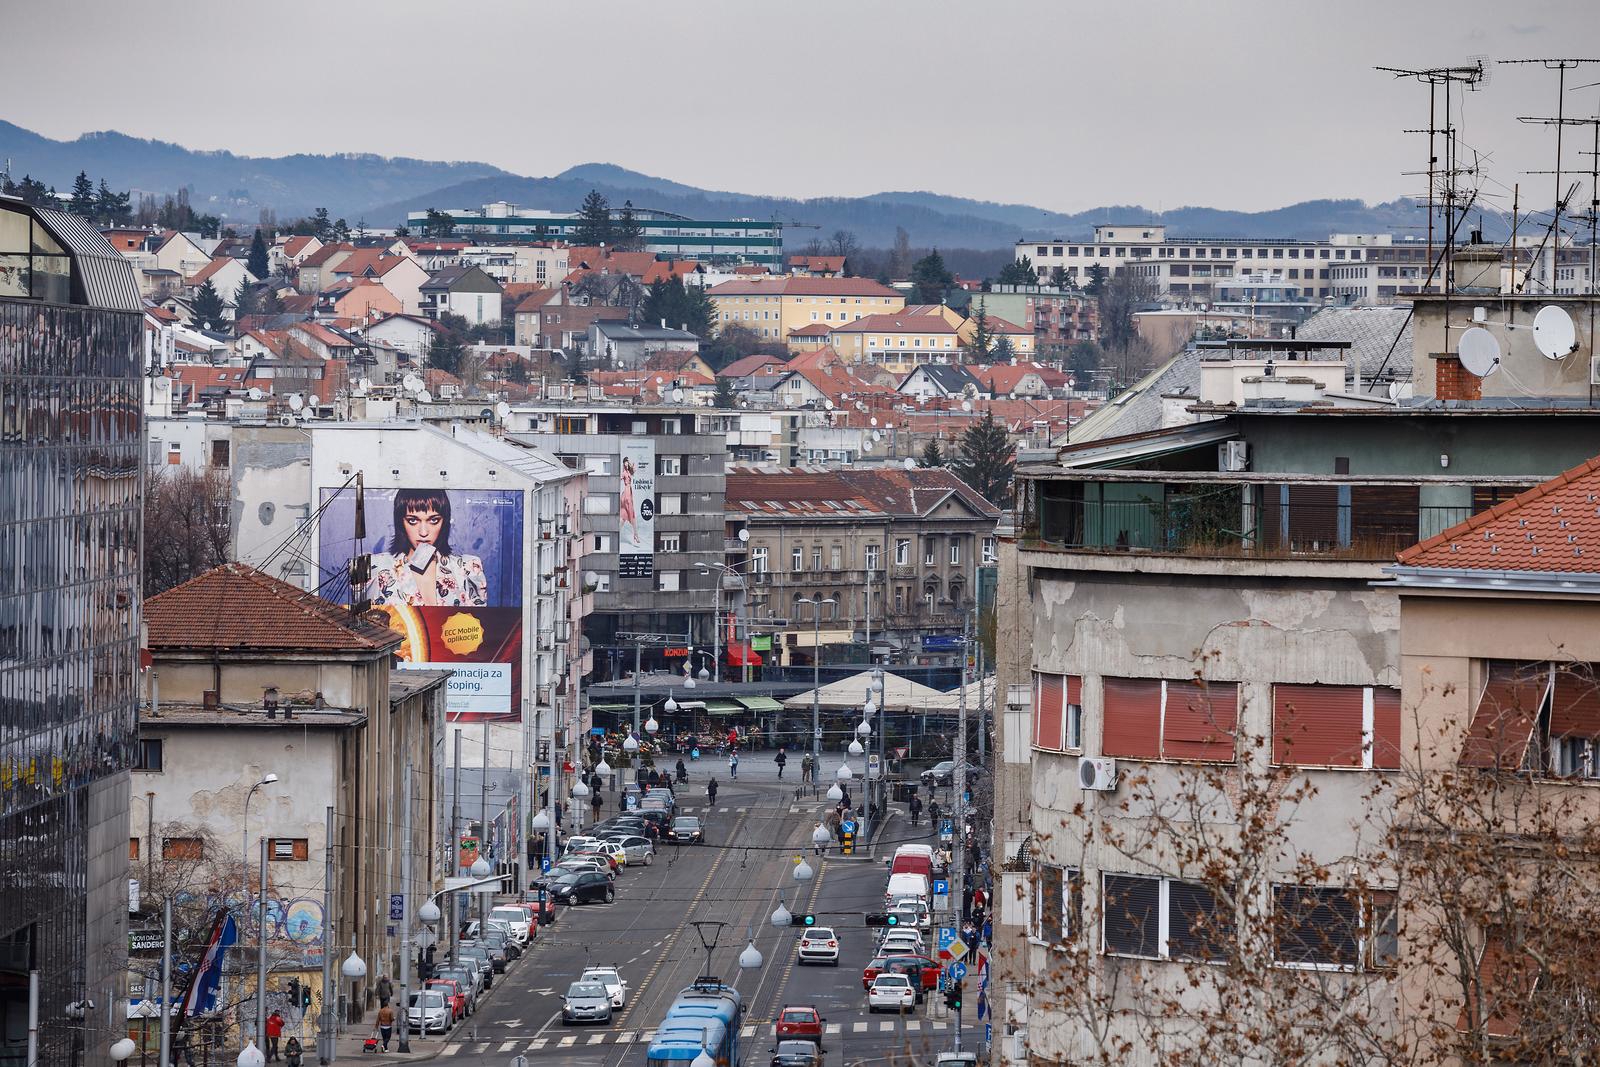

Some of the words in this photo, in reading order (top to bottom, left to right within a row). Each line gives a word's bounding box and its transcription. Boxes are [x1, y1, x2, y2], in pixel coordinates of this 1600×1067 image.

[458, 626, 480, 634] Mobile
[448, 634, 478, 643] aplikacija
[448, 681, 482, 691] šoping.
[132, 941, 164, 949] SANDERO
